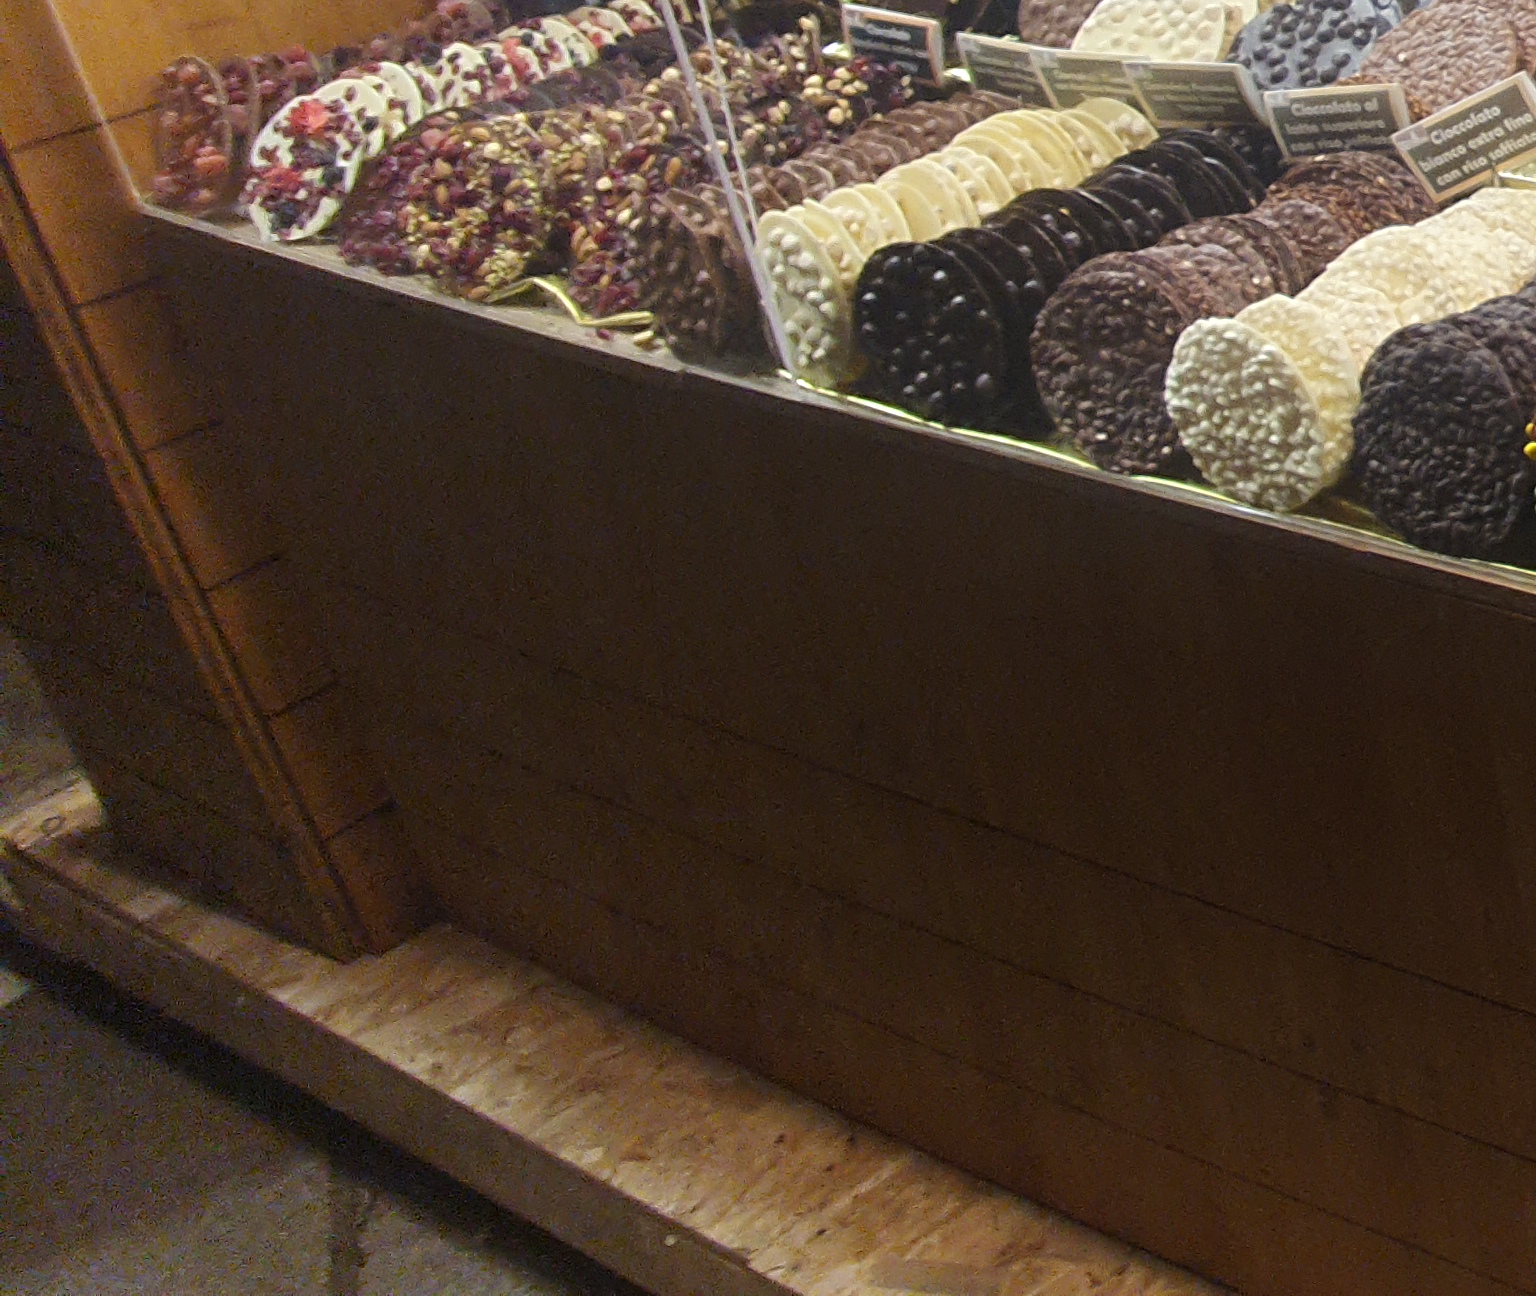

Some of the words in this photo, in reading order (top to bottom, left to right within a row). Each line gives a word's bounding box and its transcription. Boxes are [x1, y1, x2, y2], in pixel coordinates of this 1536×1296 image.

[1290, 101, 1362, 117] Cioccolato
[1430, 104, 1502, 146] Cioccolato
[1419, 142, 1466, 173] bianco
[1467, 125, 1502, 151] extra
[1436, 168, 1462, 187] con
